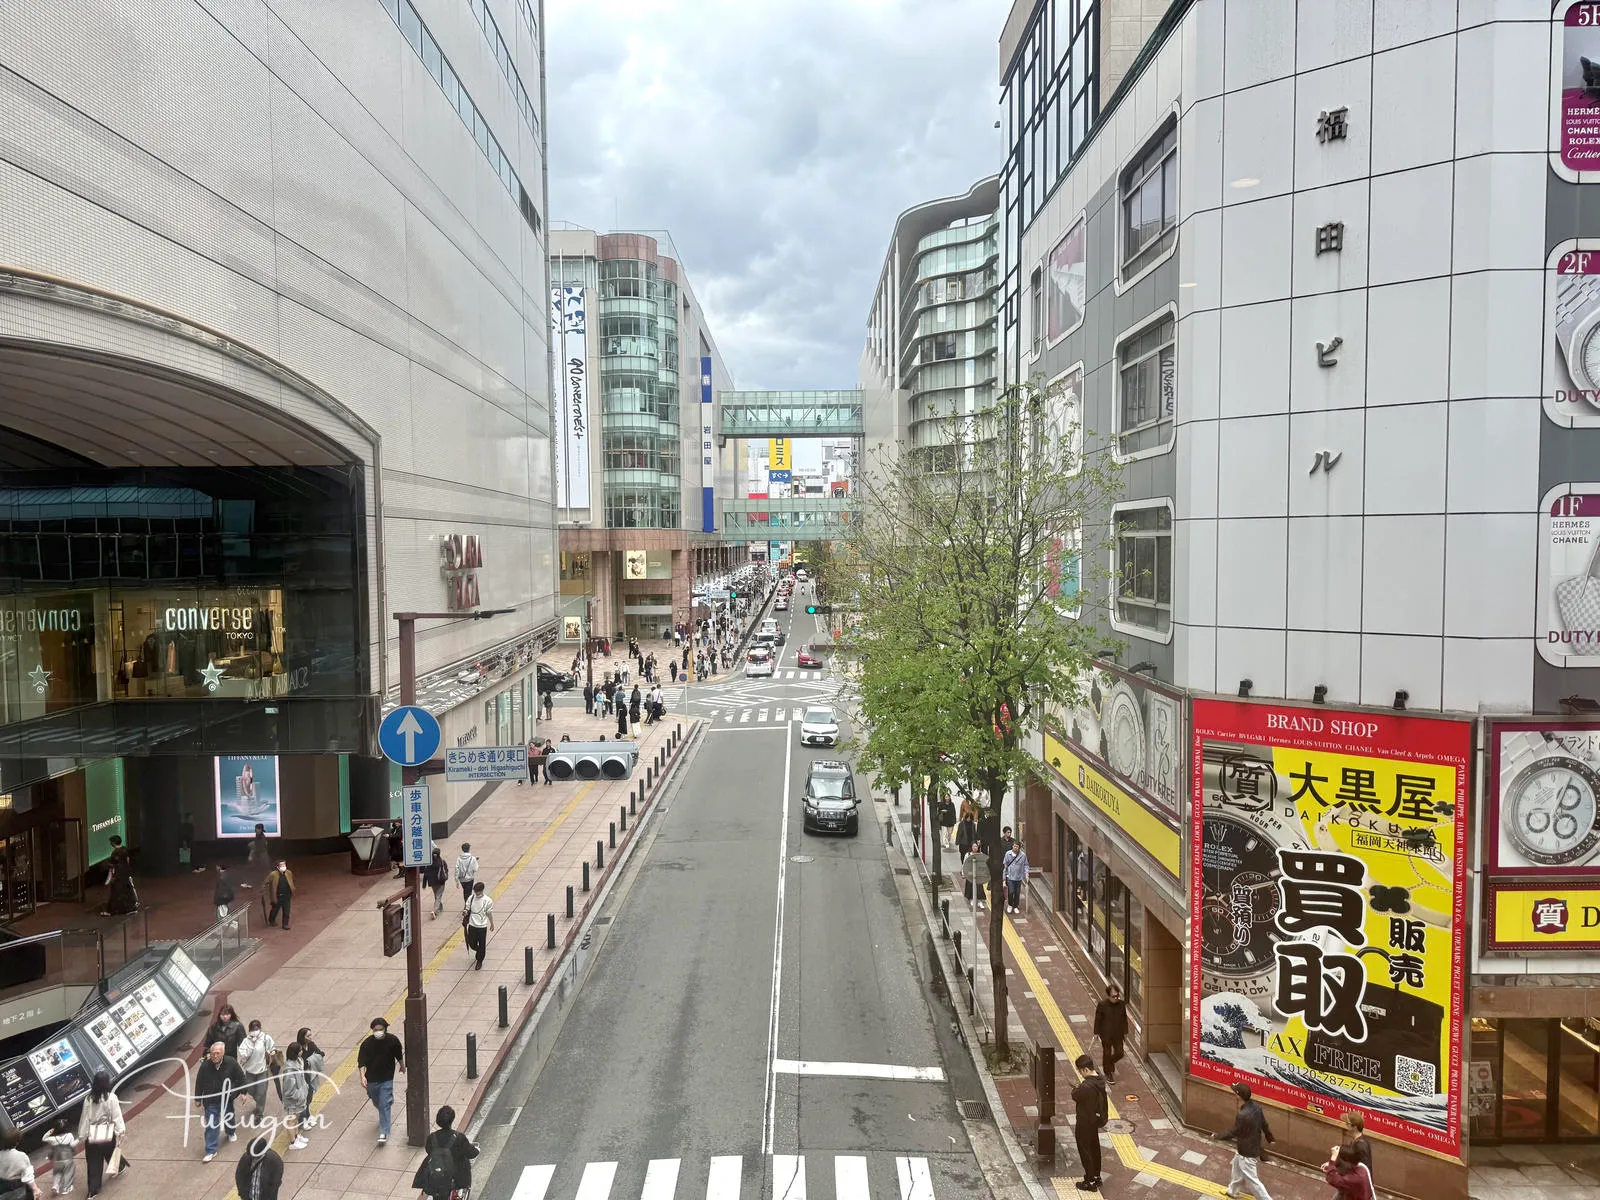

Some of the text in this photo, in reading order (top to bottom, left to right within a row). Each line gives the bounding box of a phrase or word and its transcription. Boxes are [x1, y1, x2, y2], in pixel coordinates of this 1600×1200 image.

[1564, 252, 1592, 274] 2F
[1309, 105, 1349, 476] 福田ビル
[1555, 389, 1600, 403] DUTY
[1557, 496, 1583, 516] 1F
[226, 632, 254, 640] TOKYO
[1548, 630, 1595, 643] DUTY
[1266, 713, 1379, 738] BRAND SHOP
[448, 750, 525, 763] きらめき通り東口
[1217, 730, 1236, 738] Cartier
[1314, 740, 1342, 750] VUITTON
[1345, 744, 1374, 753] CHANEL
[1377, 747, 1389, 755] Van
[1390, 748, 1406, 756] Cleef
[1415, 752, 1434, 760] Arpels
[1437, 754, 1466, 764] OMEGA
[1458, 764, 1466, 787] PATEK
[1086, 774, 1120, 816] DAIKOKUYA
[1287, 761, 1438, 824] 大黒屋
[410, 790, 424, 862] 歩車分離信号
[1284, 807, 1437, 840] DAIKOKUYA
[1456, 847, 1464, 877] WINSTON
[1455, 881, 1463, 908] TIFFANY
[1535, 902, 1565, 928] 質
[1272, 848, 1369, 1044] 買取
[1389, 915, 1425, 989] 販売
[1453, 928, 1461, 964] AUDEMARS
[1452, 992, 1460, 1016] CELINE
[1452, 1019, 1460, 1042] LOEWE
[1258, 1029, 1381, 1082] TAX FREE
[1451, 1046, 1459, 1066] GUCCI
[1263, 1055, 1372, 1096] TEL:0120-787-754
[1287, 1088, 1306, 1099] LOUIS
[1369, 1114, 1381, 1122] Van
[1406, 1125, 1425, 1136] Arpels
[1428, 1132, 1456, 1147] OMEGA
